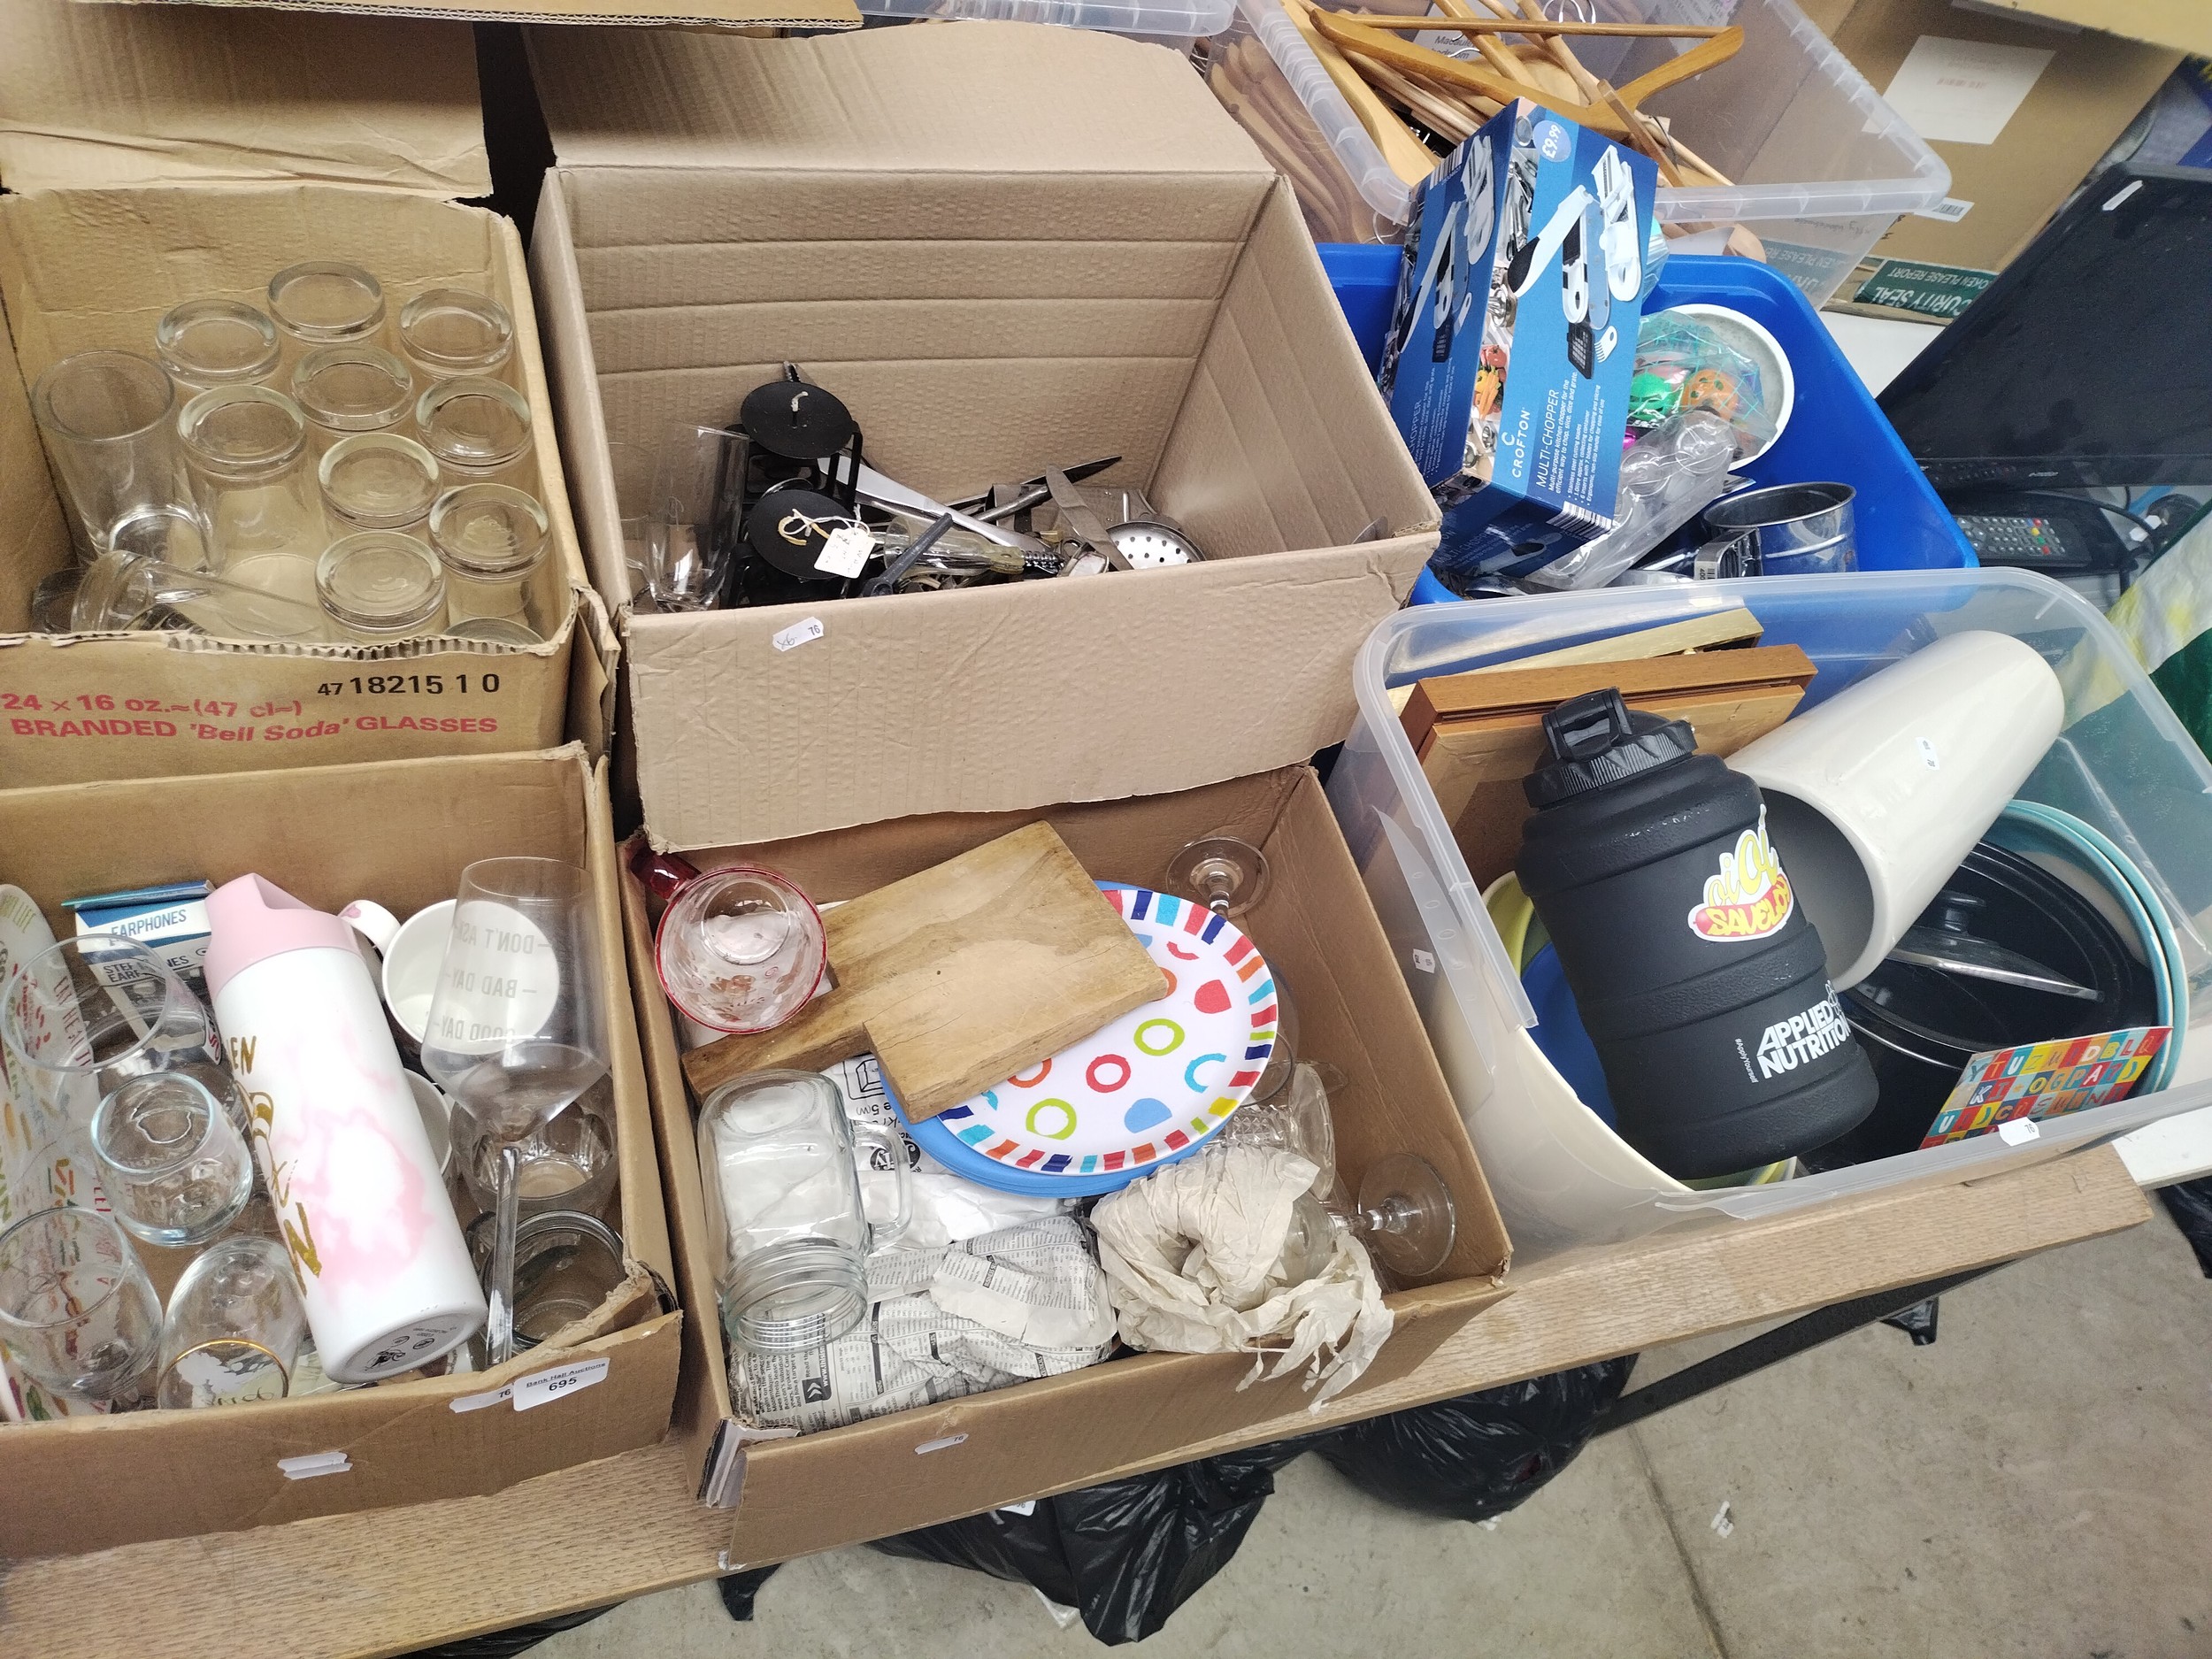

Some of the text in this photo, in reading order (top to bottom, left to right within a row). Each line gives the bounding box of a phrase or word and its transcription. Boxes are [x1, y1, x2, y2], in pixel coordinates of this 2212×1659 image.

[1542, 124, 1561, 158] £9.99
[1887, 267, 1992, 289] OKEN PLEASE REPORT
[1512, 410, 1531, 478] CROFTON
[1536, 389, 1560, 488] MULTI-CHOPPER
[1548, 448, 1560, 491] Multi-purpose
[1555, 468, 1564, 494] efficient
[807, 625, 821, 636] 76
[349, 676, 443, 695] 18215
[1, 693, 42, 710] 24
[77, 695, 115, 710] 16
[10, 718, 178, 737] BRANDED
[356, 716, 499, 733] GLASSES
[111, 909, 188, 939] EARPHONES
[1757, 1000, 1834, 1056] APPLIED
[1757, 1012, 1851, 1079] NUTRITION
[1735, 1038, 1759, 1083] #ApplyYourself
[2024, 1123, 2035, 1134] 76
[498, 1389, 511, 1398] 76
[549, 1377, 578, 1392] 695
